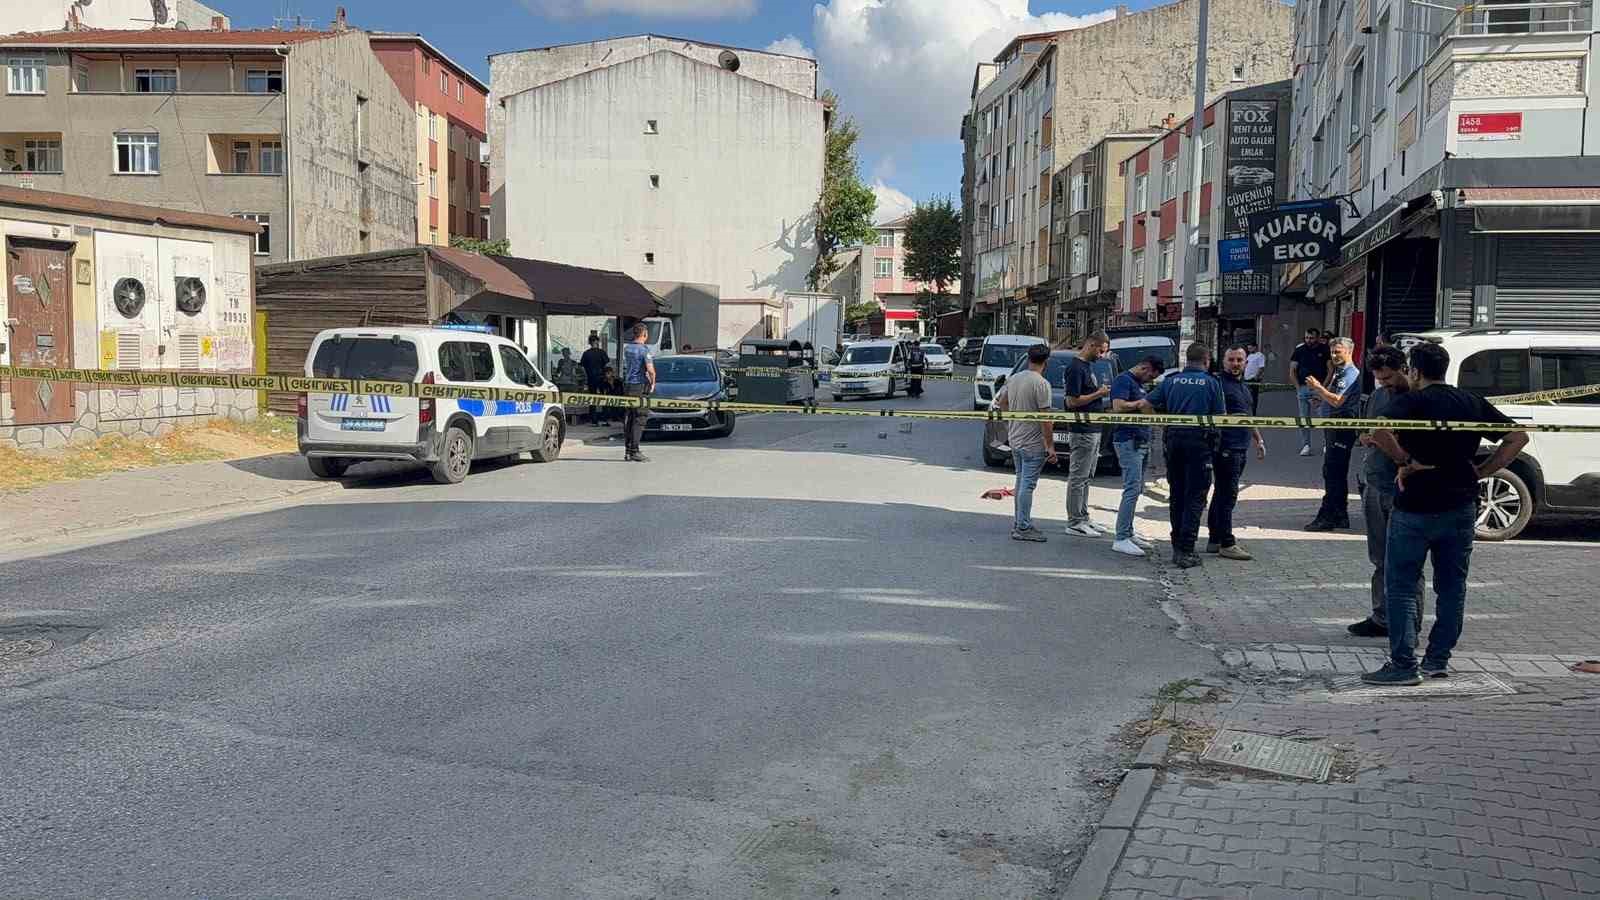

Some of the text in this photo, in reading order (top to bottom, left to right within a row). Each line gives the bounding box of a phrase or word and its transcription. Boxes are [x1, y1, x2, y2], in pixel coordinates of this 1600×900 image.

[1231, 110, 1270, 123] FOX
[1233, 125, 1273, 134] RENT A CAR
[1230, 136, 1249, 145] AUTO
[1252, 212, 1337, 249] KUAFÖR
[1273, 241, 1321, 260] EKO
